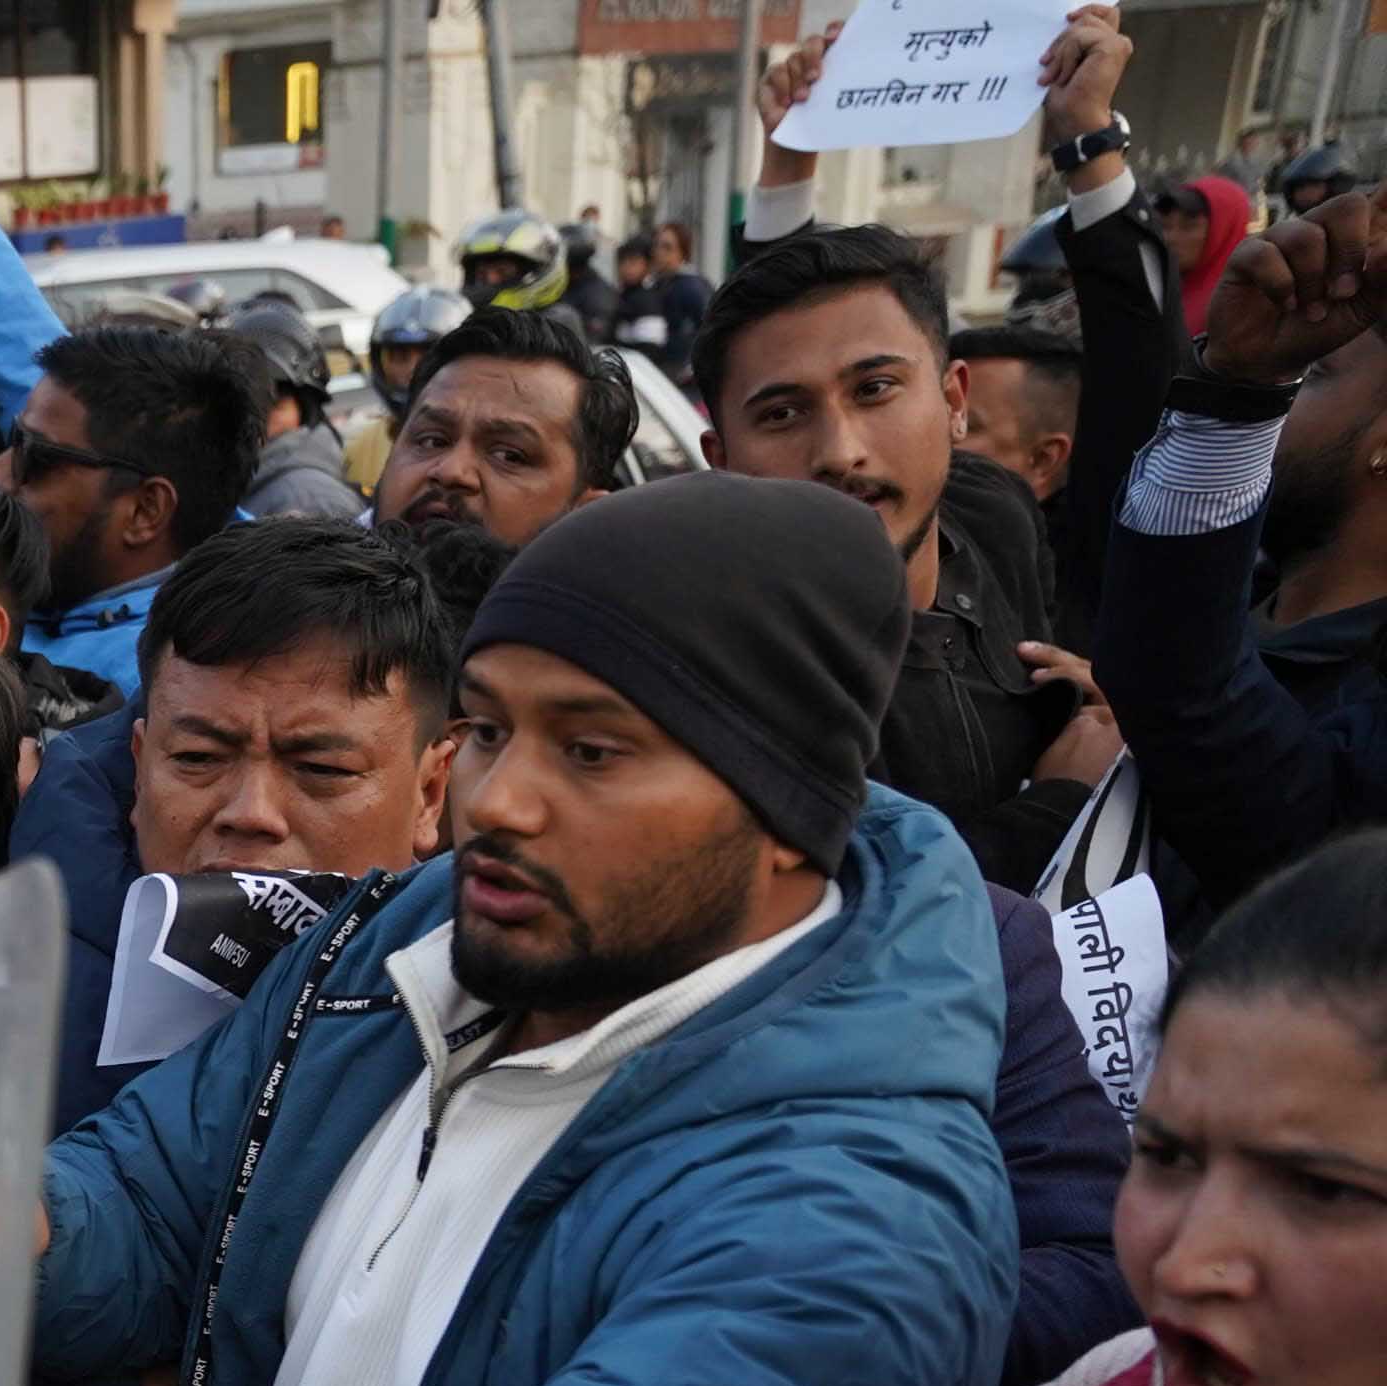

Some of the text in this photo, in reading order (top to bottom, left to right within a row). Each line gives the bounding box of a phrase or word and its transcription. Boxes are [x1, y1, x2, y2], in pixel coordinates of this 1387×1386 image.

[904, 20, 992, 61] मृत्युको
[836, 76, 1008, 109] छानबिन गर !!!
[210, 932, 252, 969] ANNFSU
[320, 912, 361, 963] E-SPORT
[1069, 896, 1126, 974] पाली
[316, 999, 372, 1010] E-SPORT
[258, 1060, 287, 1117] E-SPORT
[237, 1139, 262, 1193] E-SPORT
